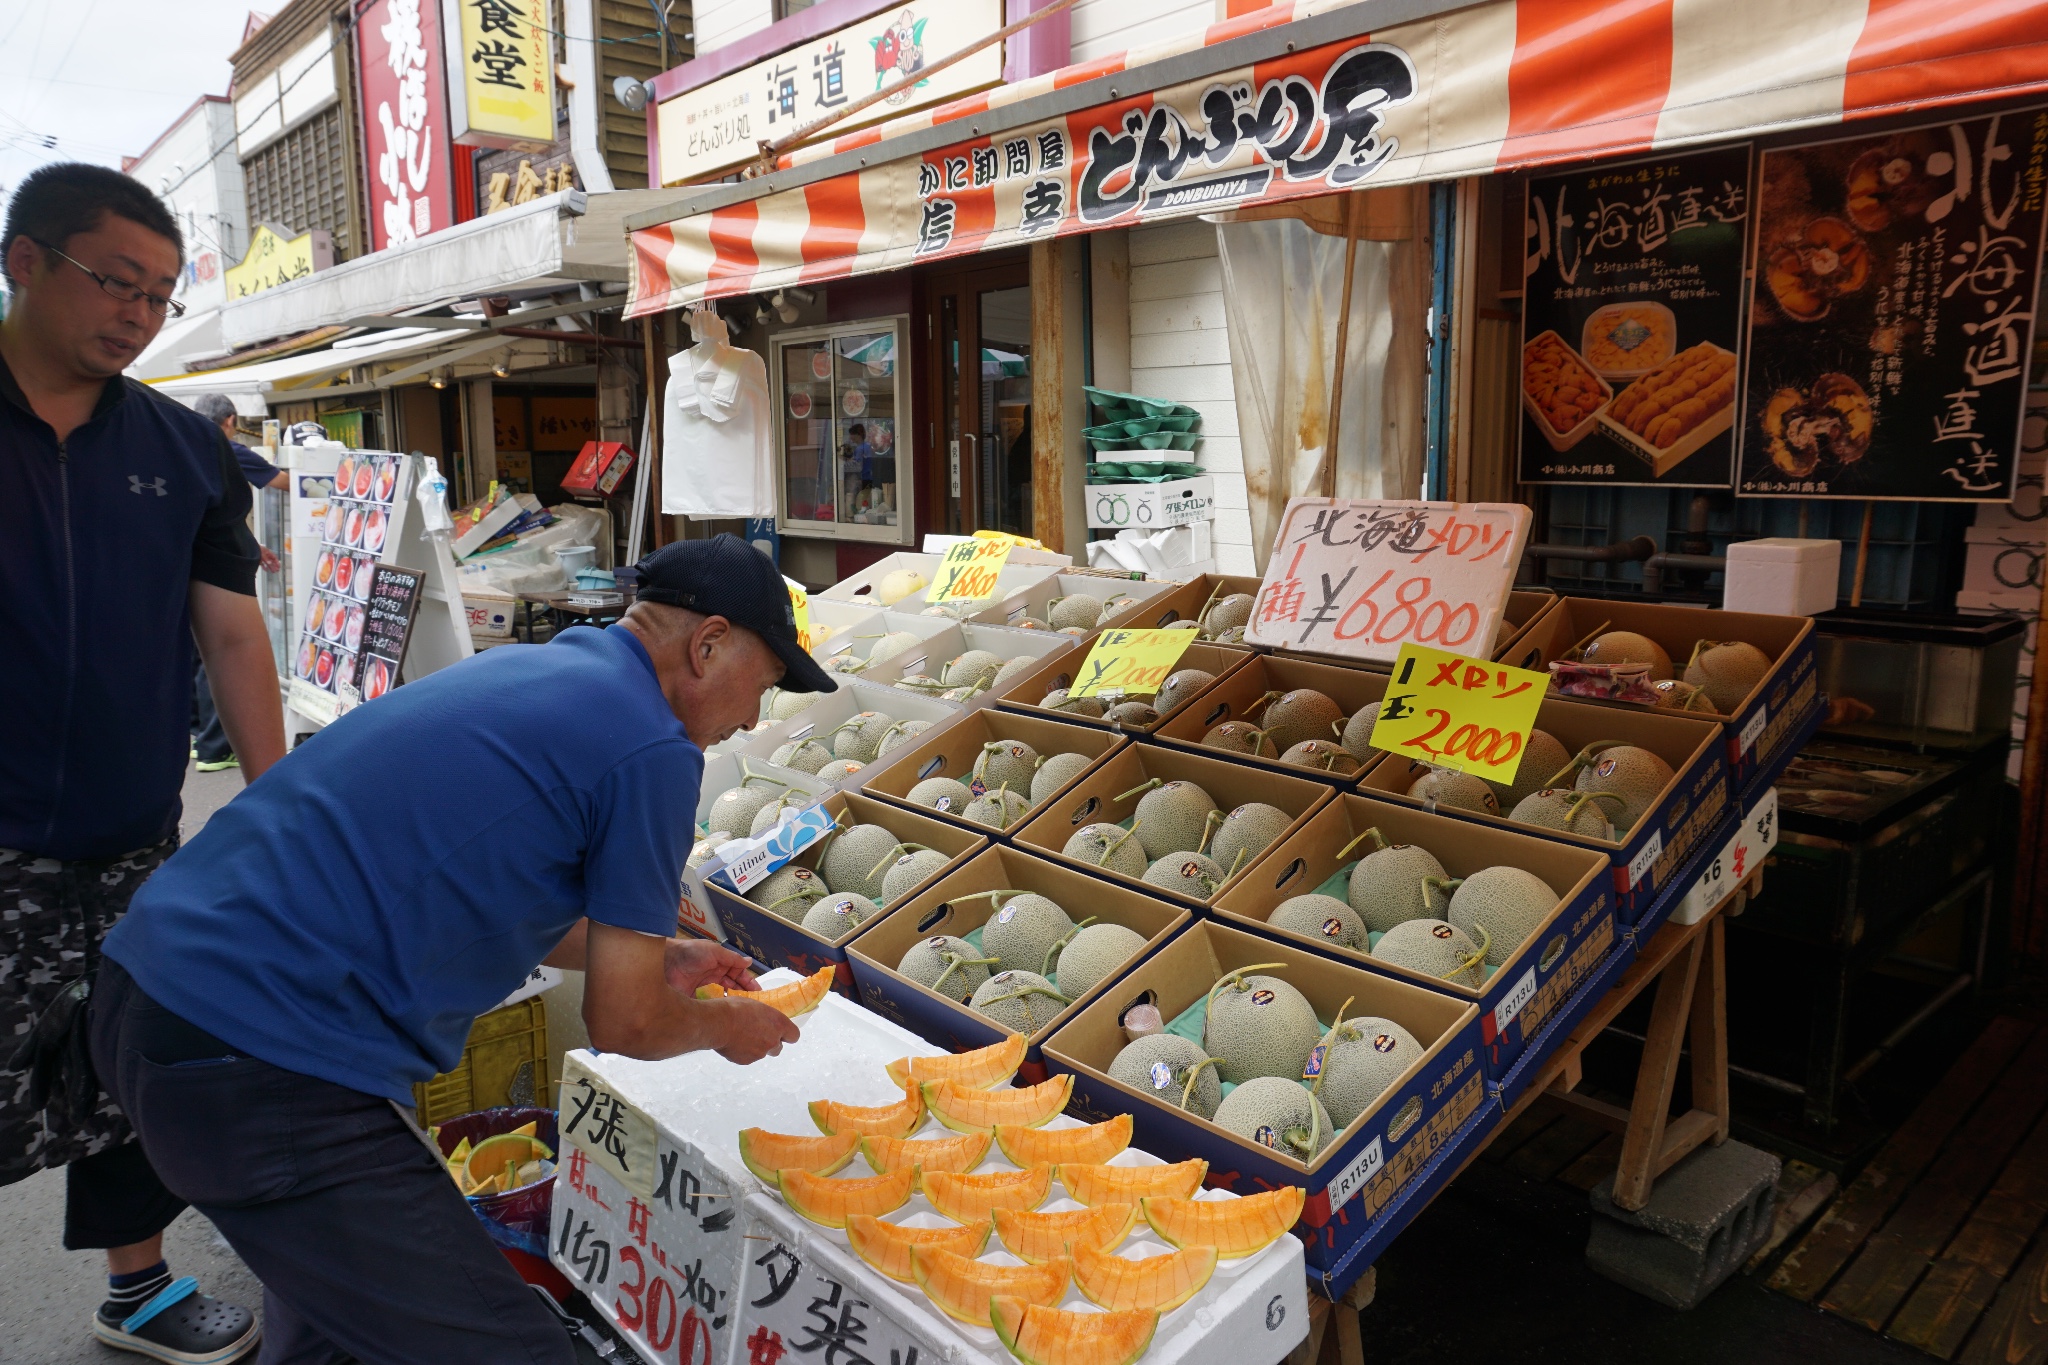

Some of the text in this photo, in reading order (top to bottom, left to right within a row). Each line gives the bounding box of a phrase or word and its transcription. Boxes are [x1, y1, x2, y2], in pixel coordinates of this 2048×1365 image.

[530, 0, 546, 94] 火炊きご飯
[767, 41, 848, 124] 海道
[687, 114, 751, 157] どんぶり処
[1079, 44, 1418, 225] どんぶり屋
[916, 129, 1067, 198] かに卸問屋
[1162, 181, 1247, 207] DONBURIYA
[731, 850, 767, 879] Lilina
[1635, 839, 1659, 875] R113U
[1504, 978, 1534, 1018] R113U
[1432, 1048, 1475, 1100] 北海道産
[1340, 1147, 1379, 1195] R113U
[1265, 1294, 1286, 1331] 6
